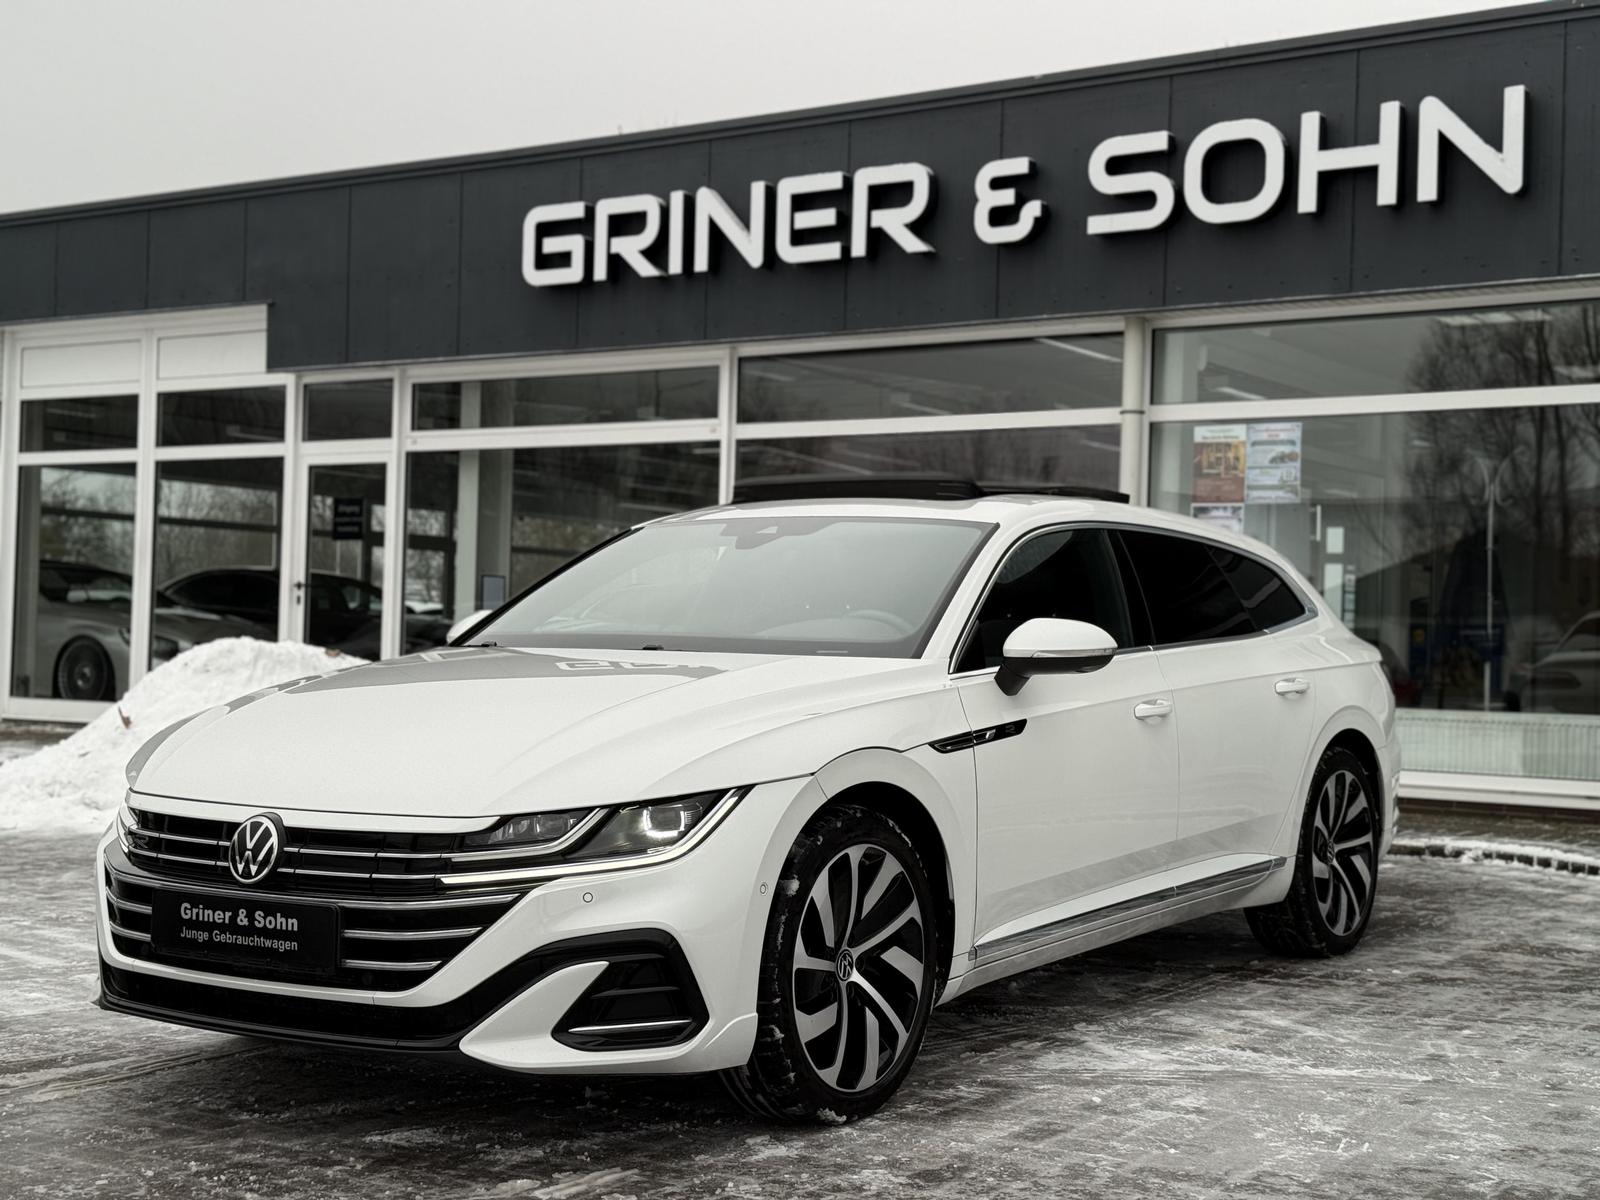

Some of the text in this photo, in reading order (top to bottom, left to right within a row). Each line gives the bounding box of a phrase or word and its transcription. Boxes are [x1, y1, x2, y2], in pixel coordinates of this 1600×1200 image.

[522, 85, 1527, 286] GRINER & SOHN
[180, 902, 298, 931] Griner & Sohn
[180, 927, 298, 951] Junge Gebrauchtwagen
